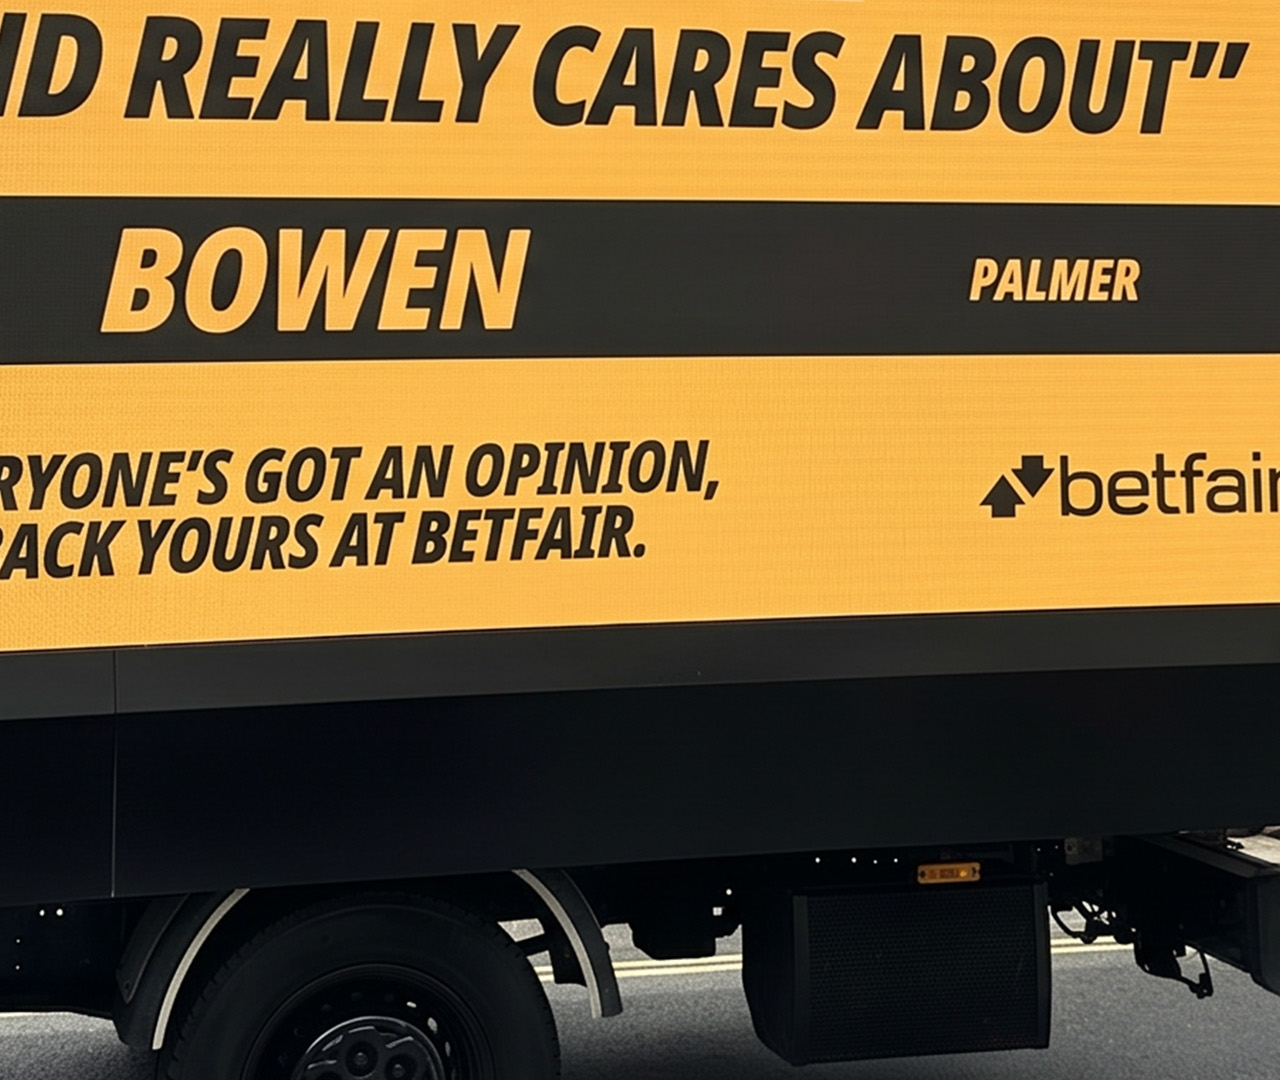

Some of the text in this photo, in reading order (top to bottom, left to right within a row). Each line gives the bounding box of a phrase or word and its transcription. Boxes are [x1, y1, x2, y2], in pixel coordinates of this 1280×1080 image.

[124, 16, 520, 123] REALLY
[533, 26, 845, 129] CARES
[856, 34, 1249, 134] ABOUT”
[101, 227, 530, 333] BOWEN
[970, 259, 1140, 300] PALMER
[245, 447, 362, 503] GOT
[365, 445, 453, 500] AN
[466, 440, 718, 500] OPINION,
[138, 514, 324, 575] YOURS
[329, 512, 405, 567] AT
[412, 505, 645, 564] BETFAIR.
